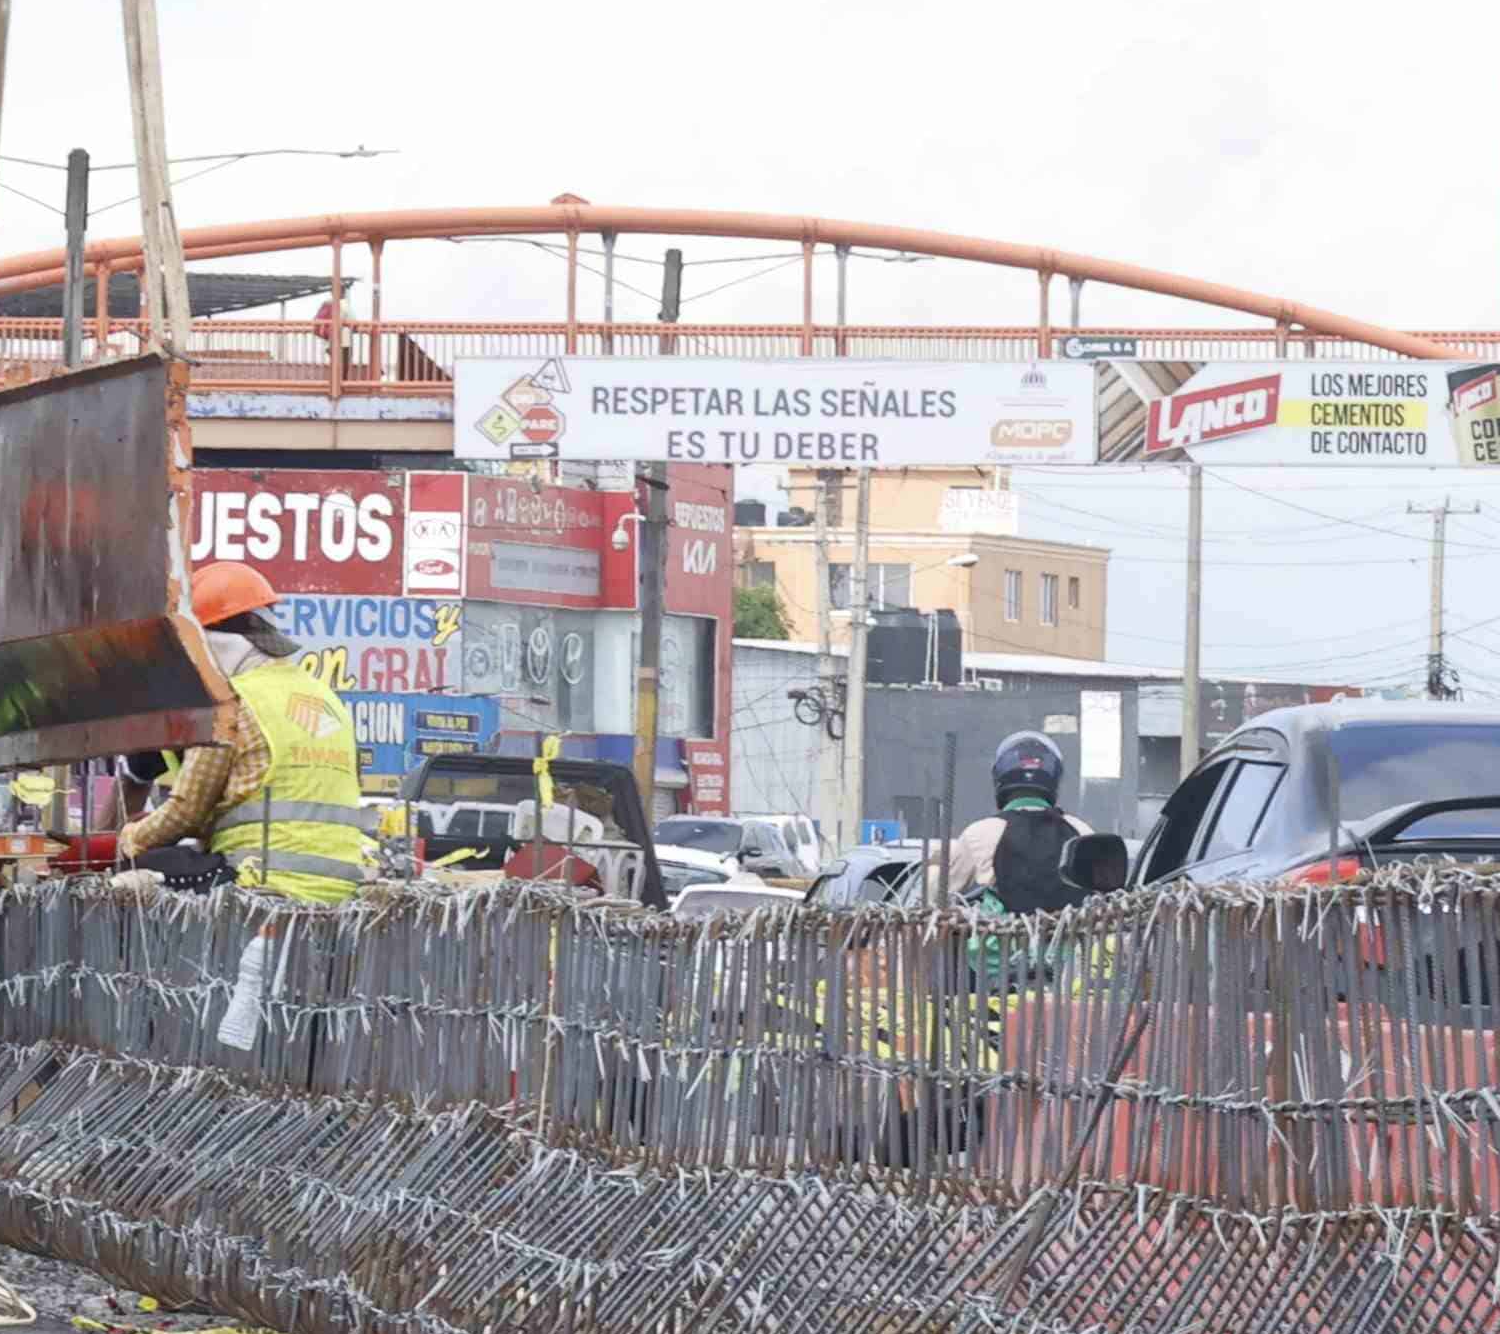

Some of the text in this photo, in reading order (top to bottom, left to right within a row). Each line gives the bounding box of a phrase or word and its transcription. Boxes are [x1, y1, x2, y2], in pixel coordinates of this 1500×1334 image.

[1311, 374, 1428, 397] LOS MEJORES
[591, 381, 957, 419] RESPETAR LAS SEÑALES
[1156, 387, 1270, 447] LANCO
[1311, 403, 1405, 426] CEMENTOS
[997, 423, 1071, 439] MOPC
[1311, 431, 1427, 455] DE CONTACTO
[667, 430, 879, 462] ES TU DEBER
[275, 598, 461, 646] ERVICIOS y
